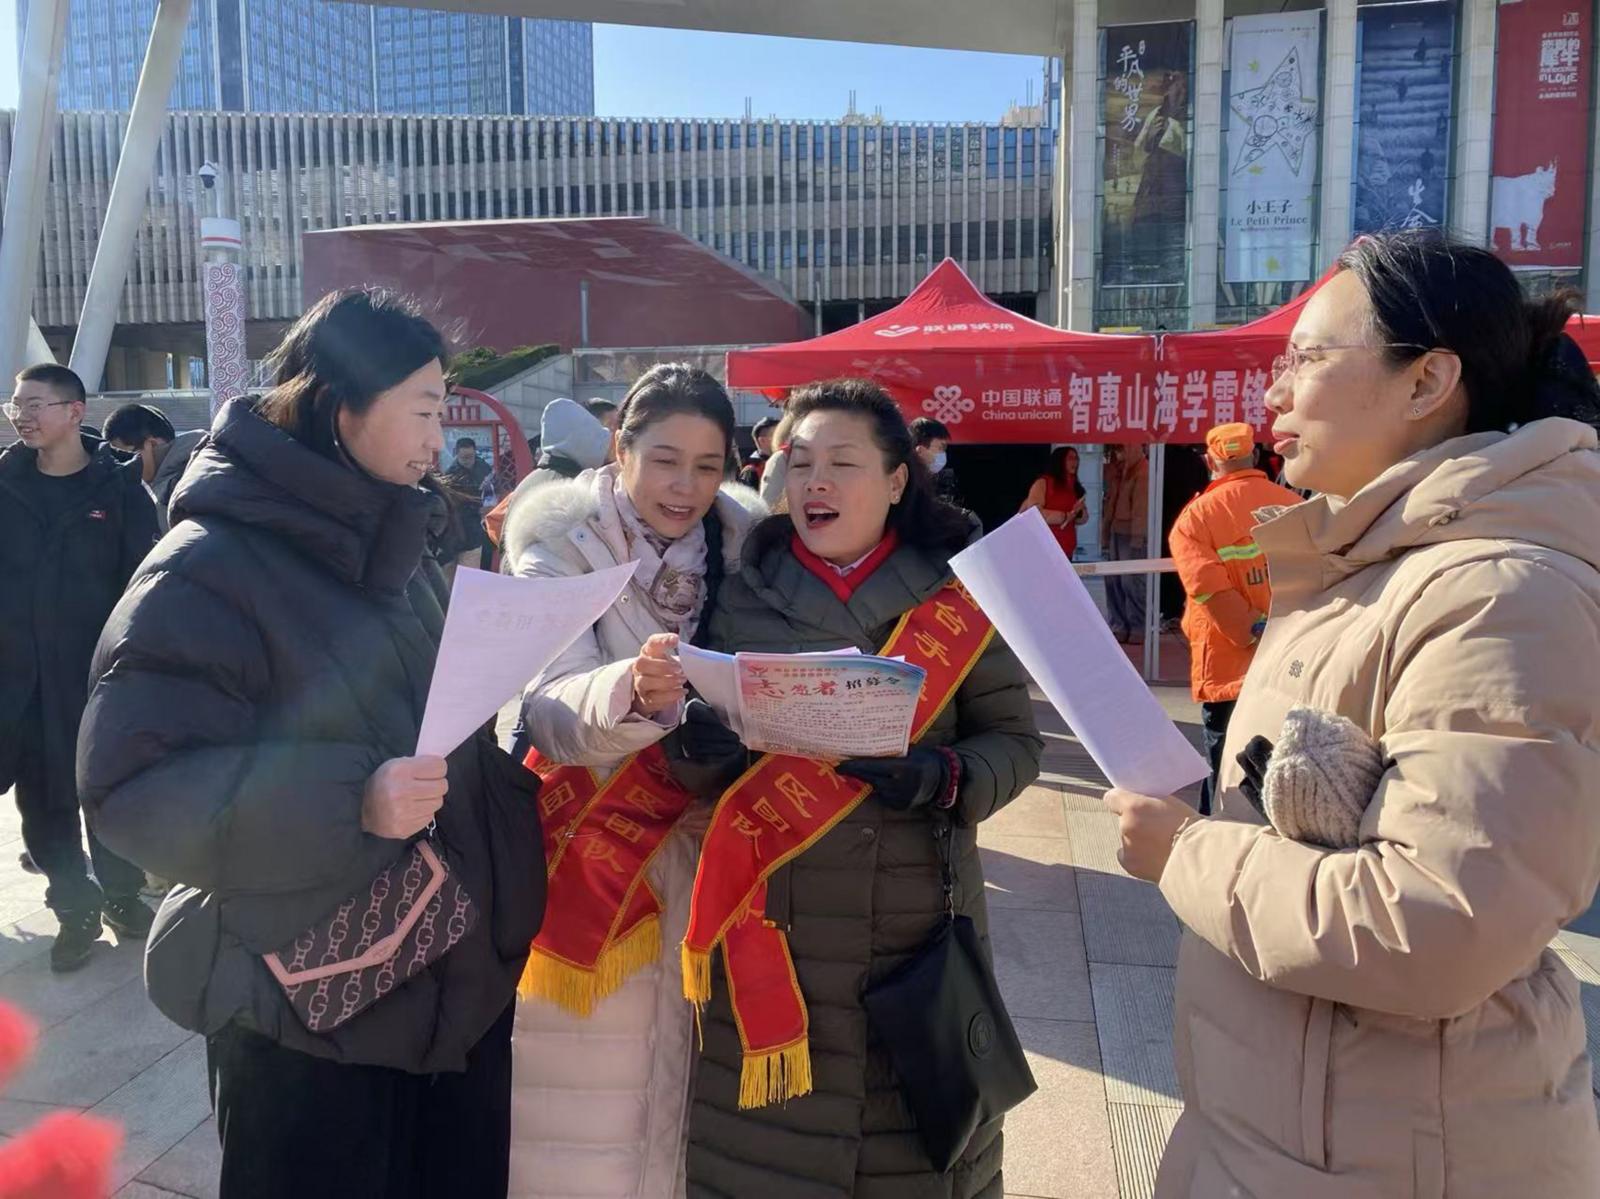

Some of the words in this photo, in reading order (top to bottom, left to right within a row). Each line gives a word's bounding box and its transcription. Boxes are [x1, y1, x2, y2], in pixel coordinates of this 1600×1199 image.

[1247, 199, 1293, 214] 小王子
[1231, 217, 1243, 226] Le
[1246, 216, 1270, 226] Petit
[1274, 216, 1308, 226] Prince
[982, 388, 1062, 407] 中国联通
[982, 410, 1016, 420] China
[1018, 410, 1062, 420] unicom
